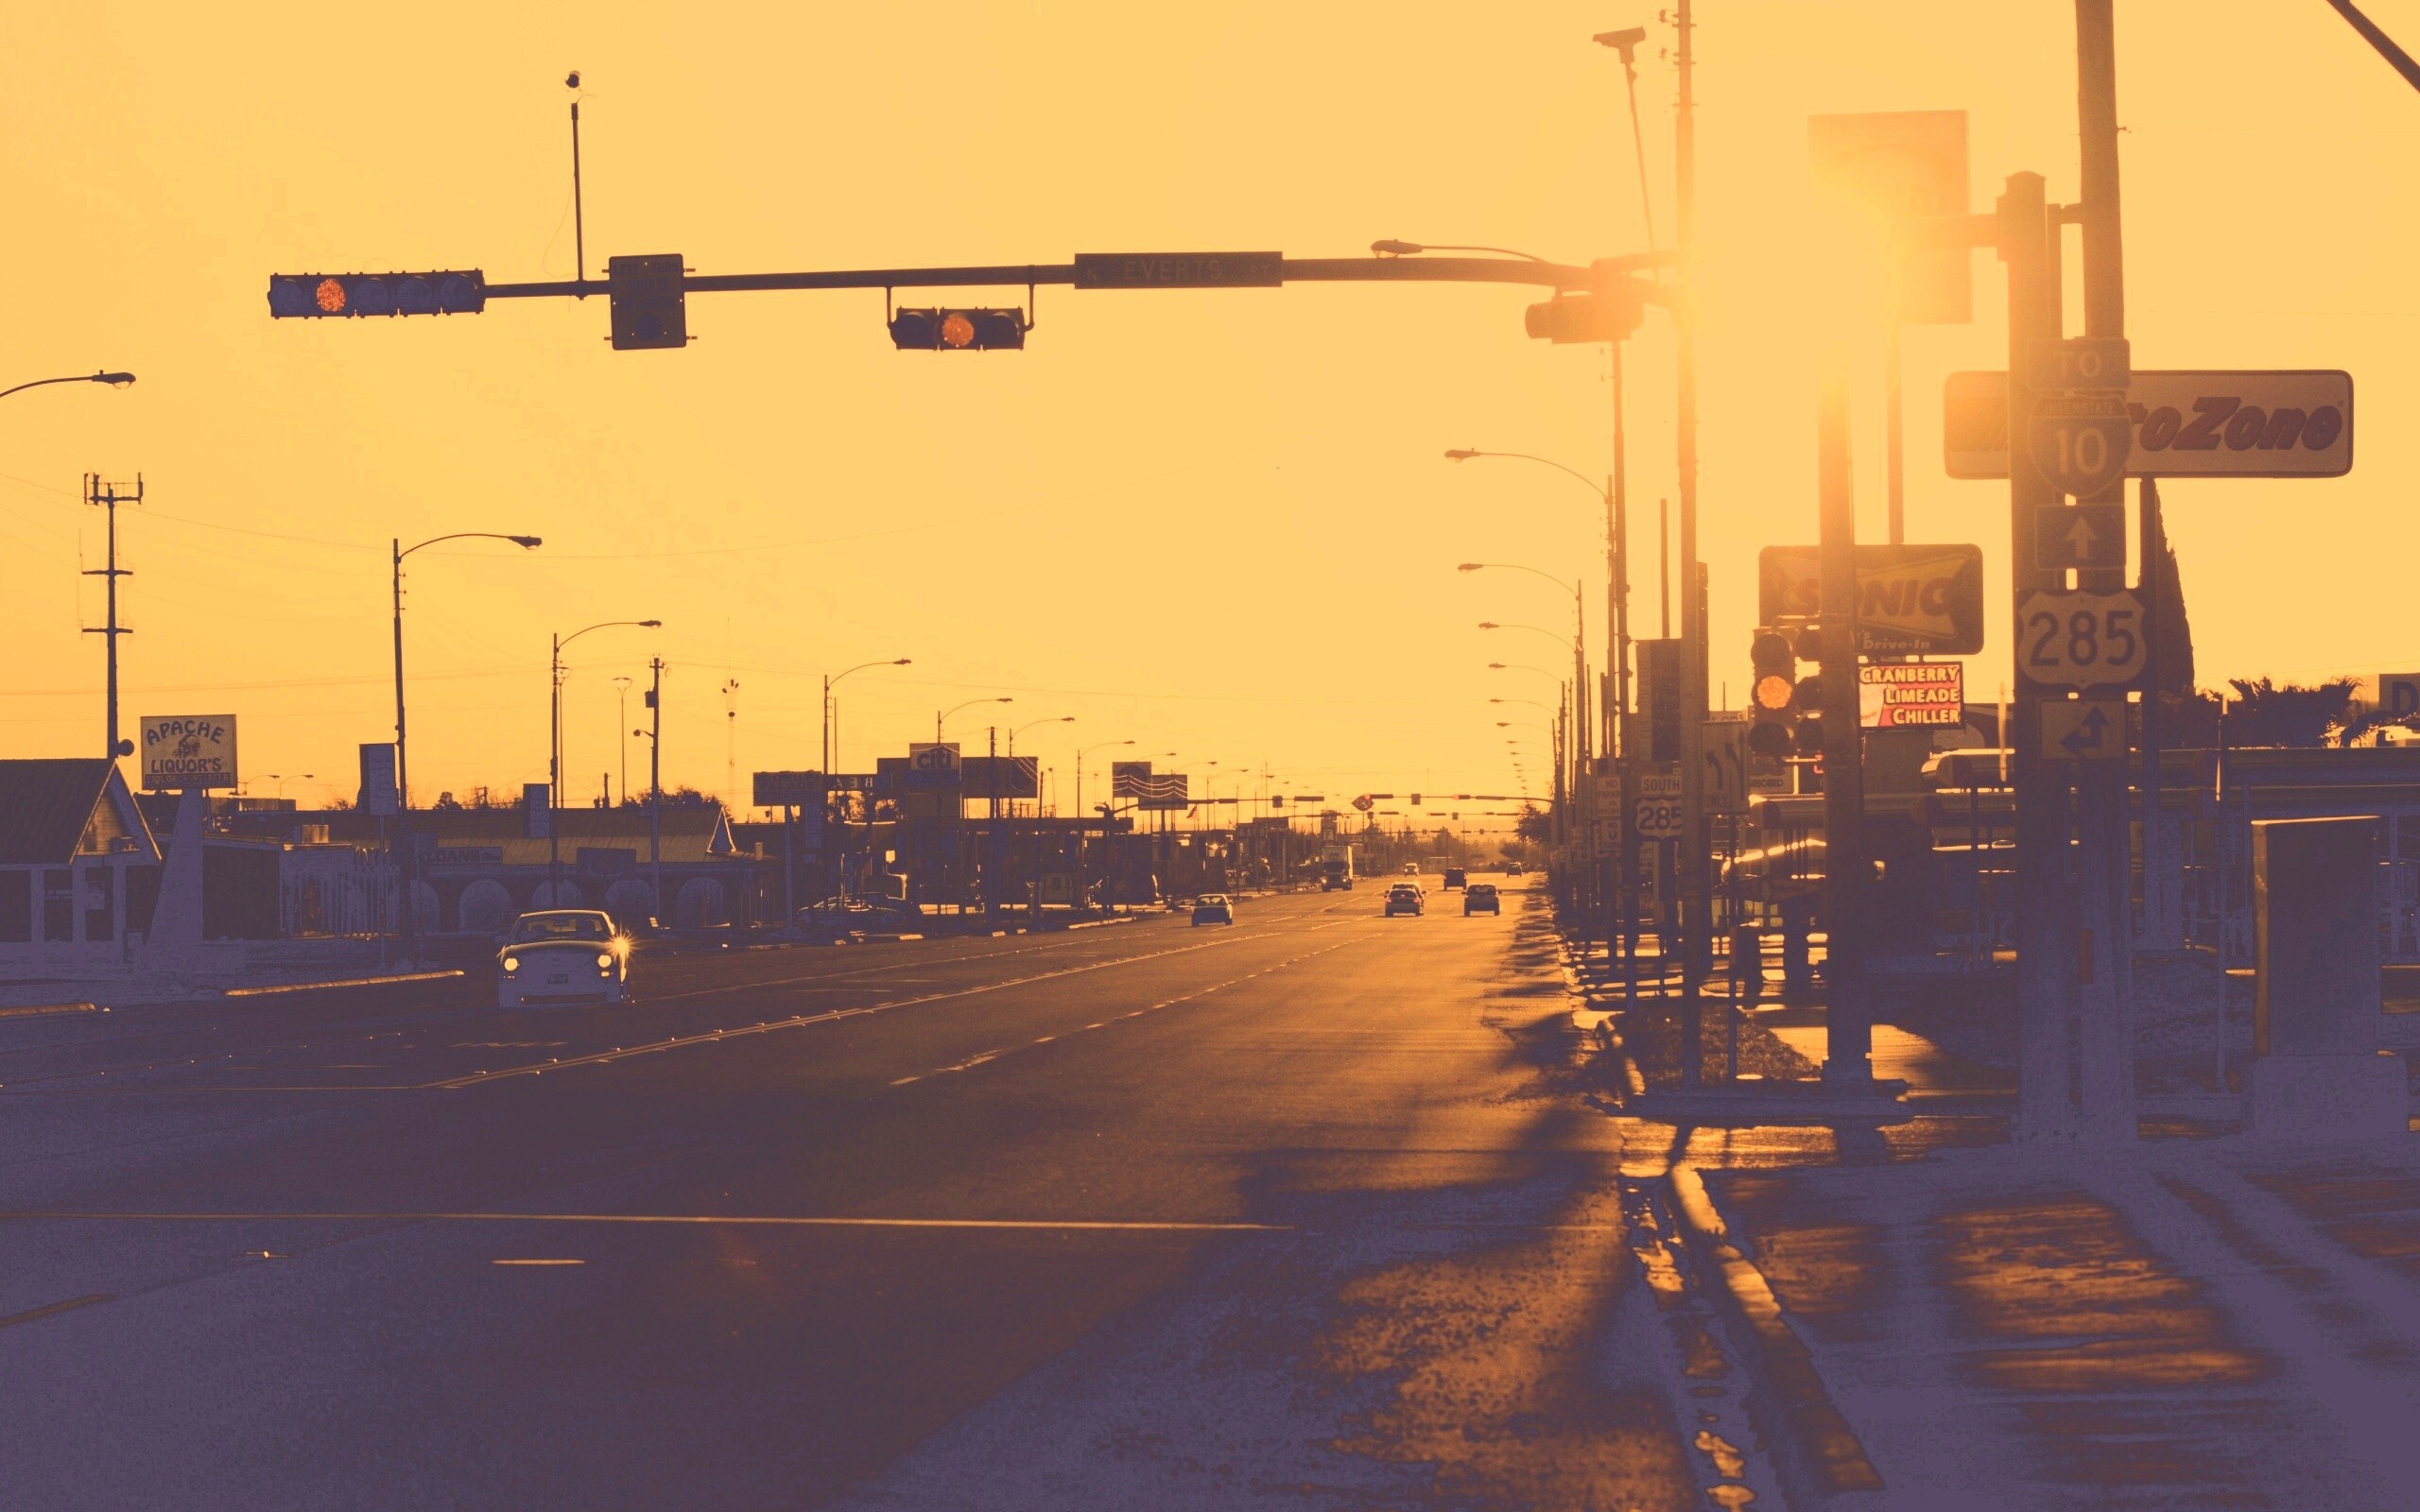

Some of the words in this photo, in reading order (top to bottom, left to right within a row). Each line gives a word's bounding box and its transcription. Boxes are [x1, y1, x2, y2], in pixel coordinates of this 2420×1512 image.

[1124, 259, 1223, 282] EVERTS
[2053, 350, 2101, 379] TO
[2044, 401, 2115, 416] INTERSTATE
[2127, 397, 2344, 452] oZone
[2055, 427, 2108, 475] 10
[1782, 577, 1957, 619] SNIC
[2029, 610, 2135, 667] 285
[1859, 666, 1959, 684] CRANBERRY
[1884, 687, 1960, 705] LIMEADE
[1893, 708, 1961, 725] CHILLER
[147, 719, 226, 747] APACHE
[151, 758, 222, 773] LIQUOR'S
[917, 752, 952, 770] citi
[1605, 779, 1618, 788] NO
[1643, 779, 1681, 792] SOUTH
[1638, 805, 1682, 830] 285
[1608, 830, 1618, 840] U
